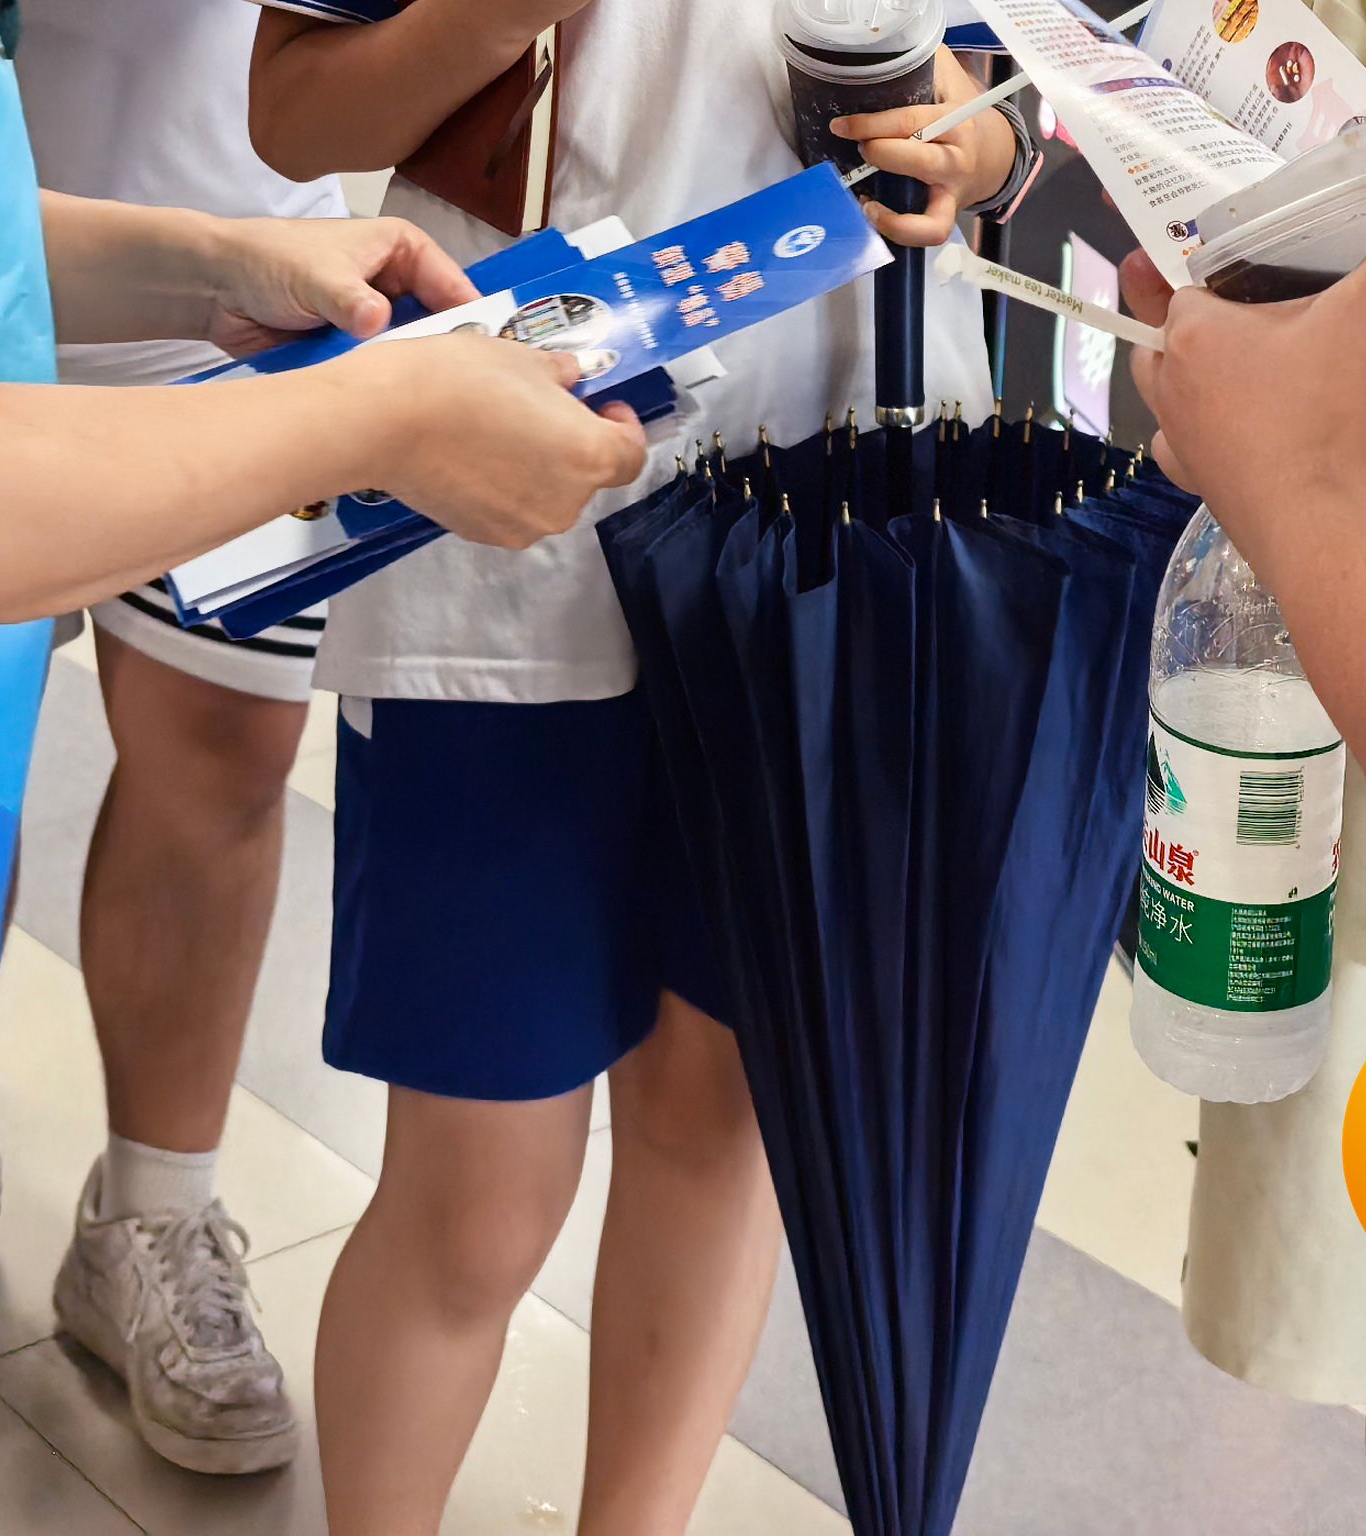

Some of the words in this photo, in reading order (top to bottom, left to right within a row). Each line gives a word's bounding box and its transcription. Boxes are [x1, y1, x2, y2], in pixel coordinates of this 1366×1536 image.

[986, 264, 1022, 285] maker
[1024, 279, 1042, 292] tea
[1044, 288, 1084, 314] Master
[1144, 820, 1195, 886] 山泉
[1163, 886, 1195, 913] WATER
